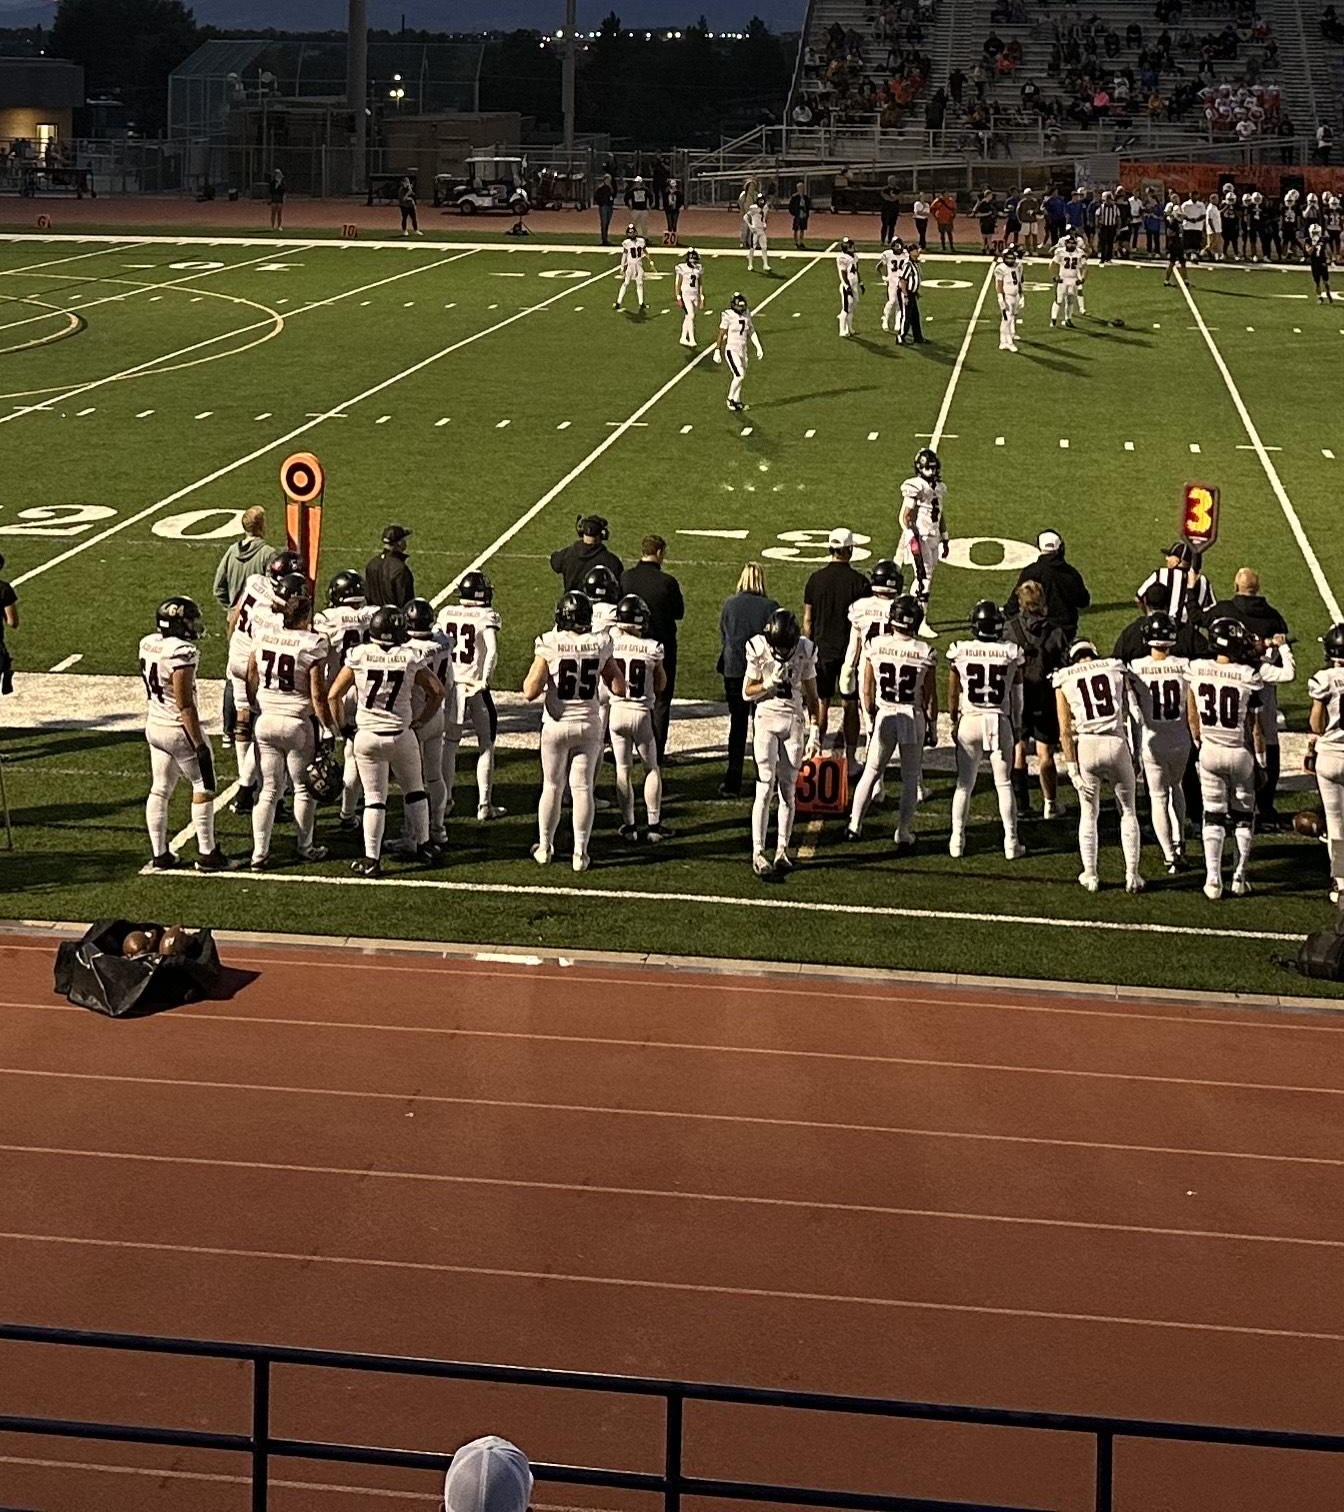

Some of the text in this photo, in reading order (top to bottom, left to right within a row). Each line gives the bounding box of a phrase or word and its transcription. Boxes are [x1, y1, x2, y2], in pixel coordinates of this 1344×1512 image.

[342, 224, 355, 236] 10
[663, 233, 676, 244] 20
[739, 320, 745, 335] 7
[1186, 486, 1213, 534] 3
[262, 649, 295, 692] 79
[365, 669, 405, 711] 77
[558, 659, 600, 700] 65
[879, 662, 918, 703] 22
[966, 663, 1008, 704] 25
[1077, 674, 1115, 720] 19
[1150, 679, 1181, 721] 10
[1199, 683, 1240, 729] 30
[797, 760, 840, 804] 30
